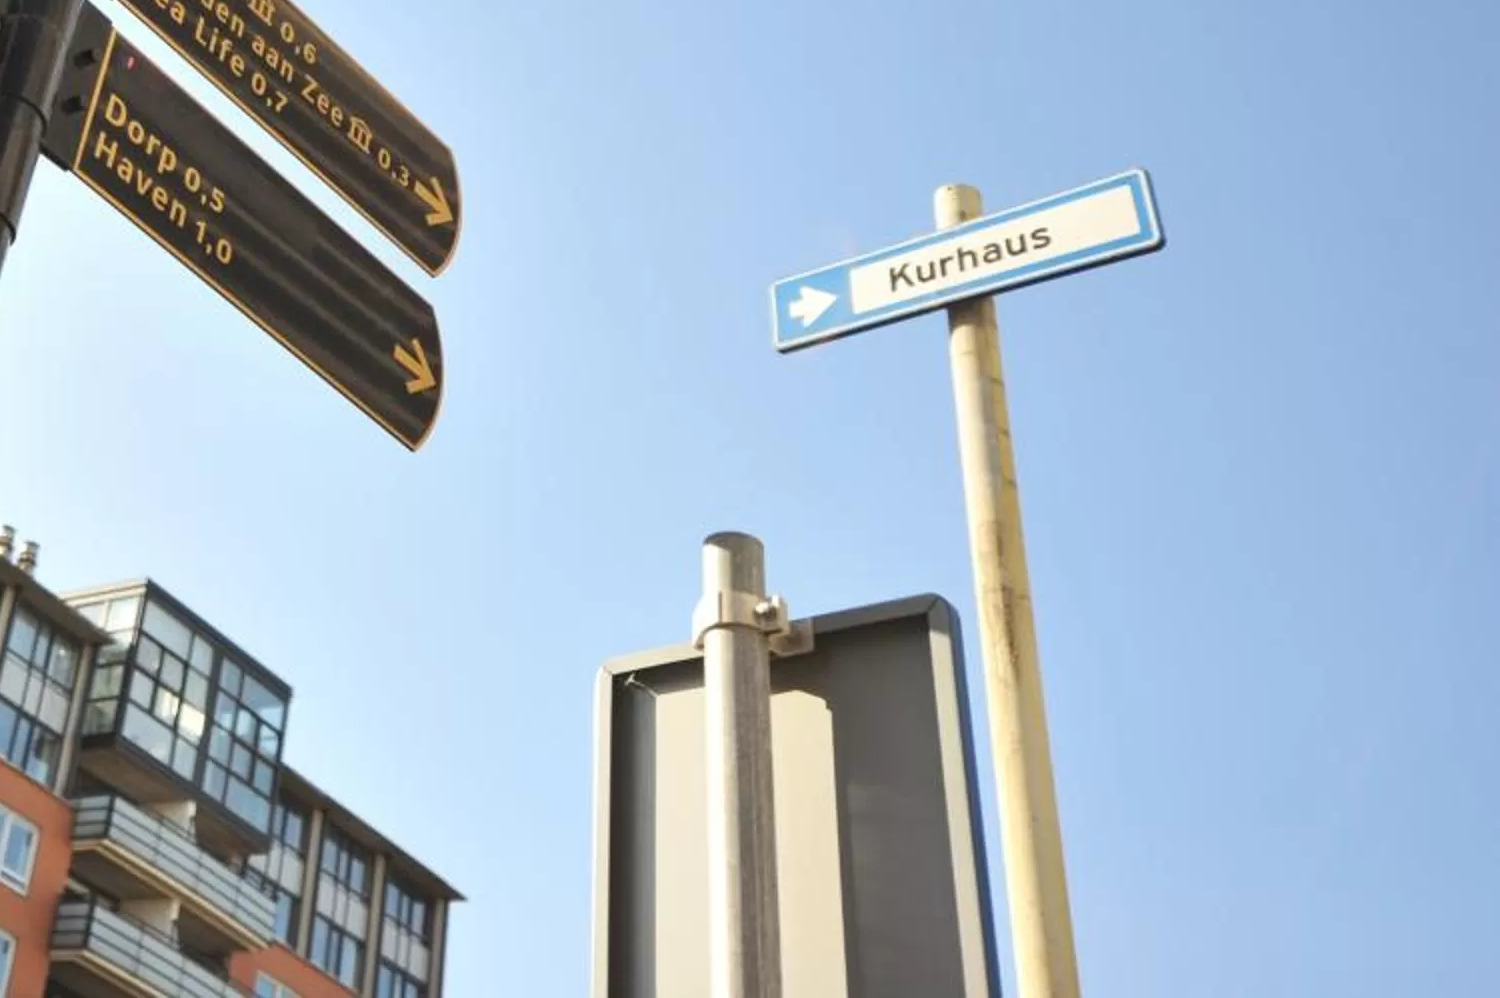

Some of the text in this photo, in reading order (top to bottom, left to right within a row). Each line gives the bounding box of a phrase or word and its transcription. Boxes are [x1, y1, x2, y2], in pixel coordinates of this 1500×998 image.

[195, 16, 245, 78] Life
[251, 37, 294, 83] aan
[301, 74, 343, 128] Zee
[94, 131, 233, 266] Haven 1,0
[104, 93, 225, 214] Dorp 0,5
[888, 226, 1052, 292] Kurhaus
